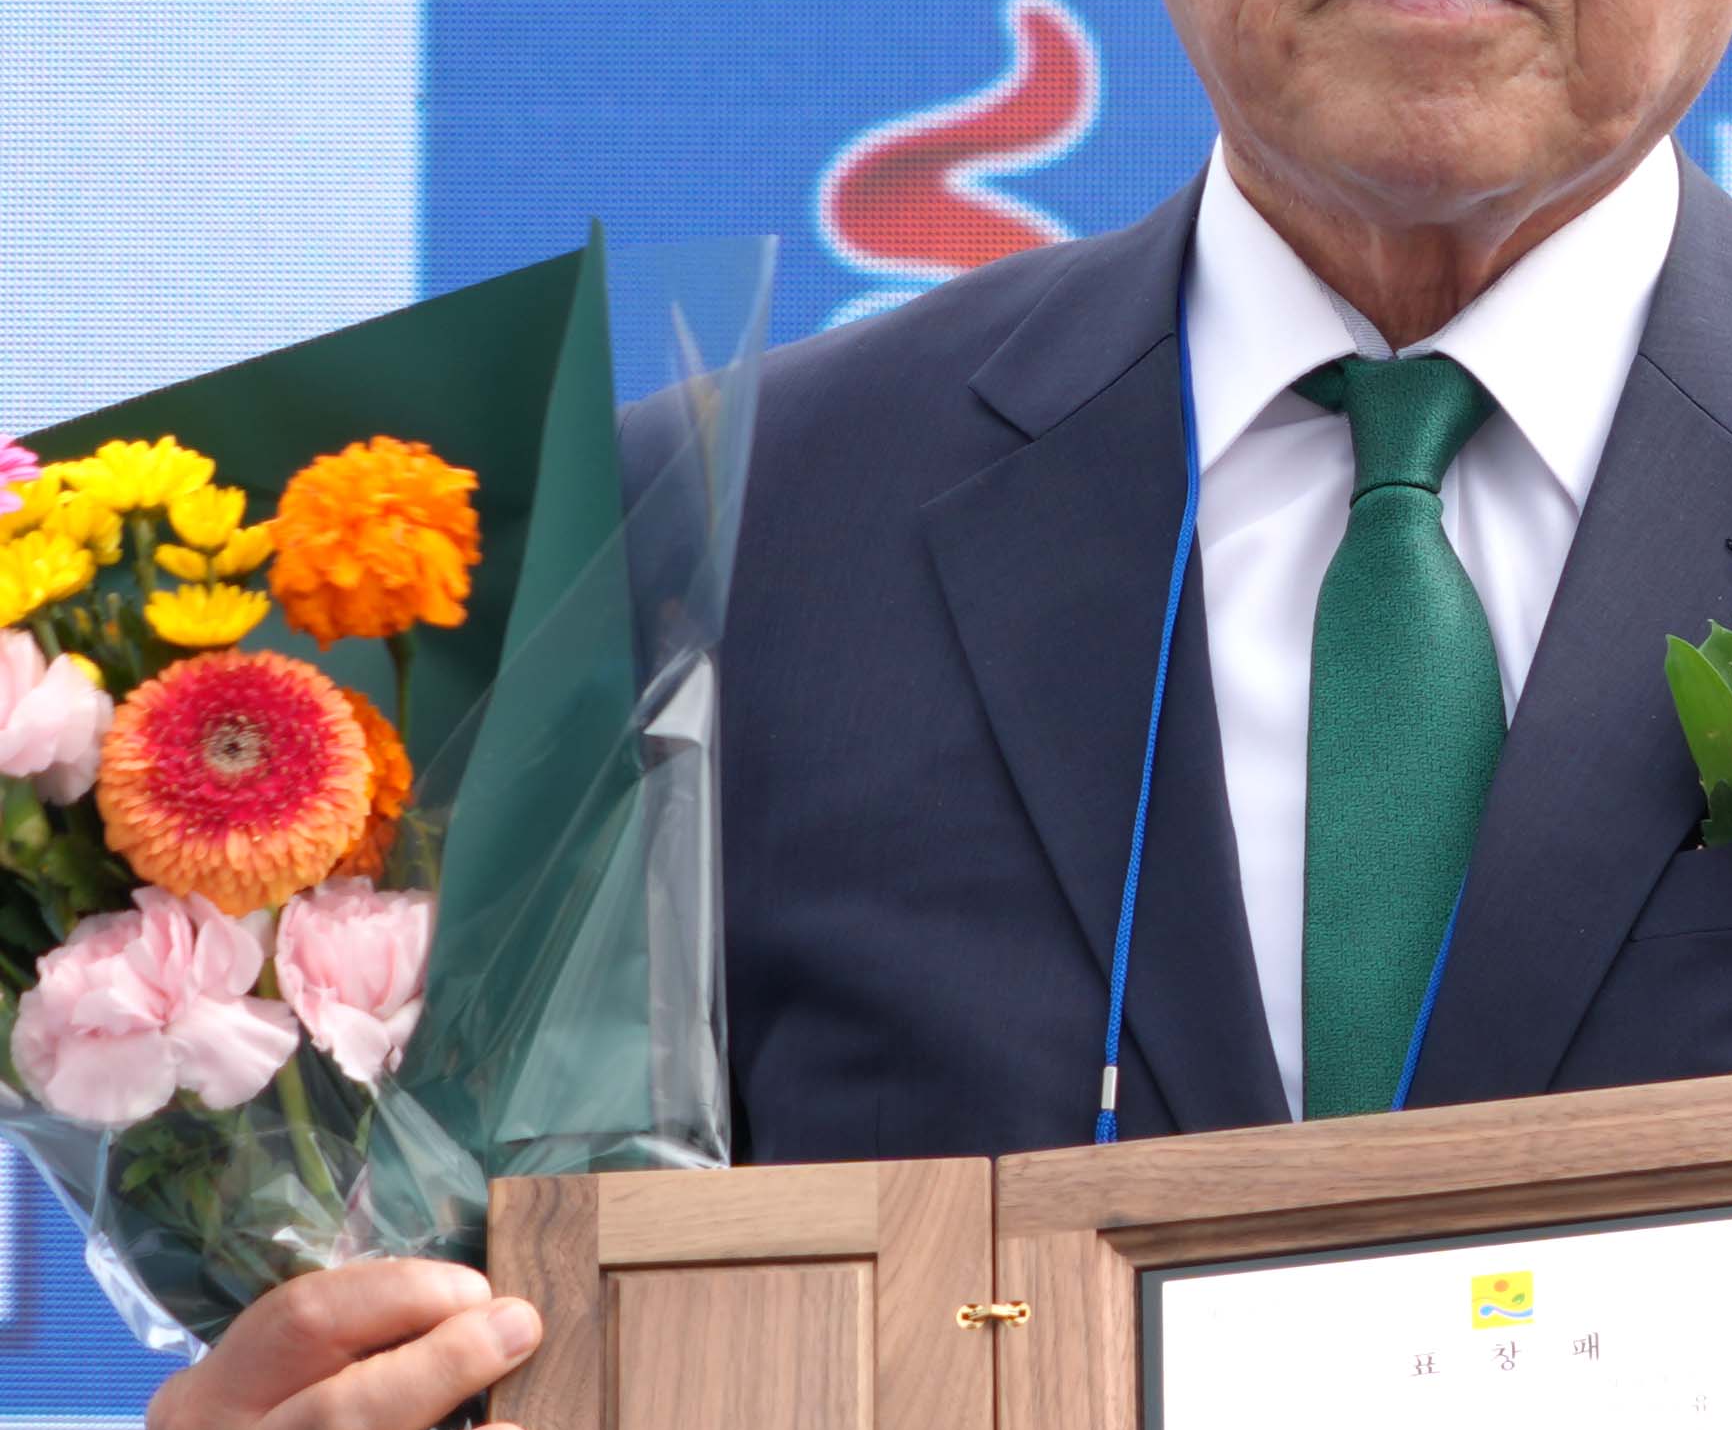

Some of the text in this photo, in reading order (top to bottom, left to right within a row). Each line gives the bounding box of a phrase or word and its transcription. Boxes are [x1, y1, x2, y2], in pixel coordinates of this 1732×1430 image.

[1411, 1332, 1601, 1377] 표 창 패
